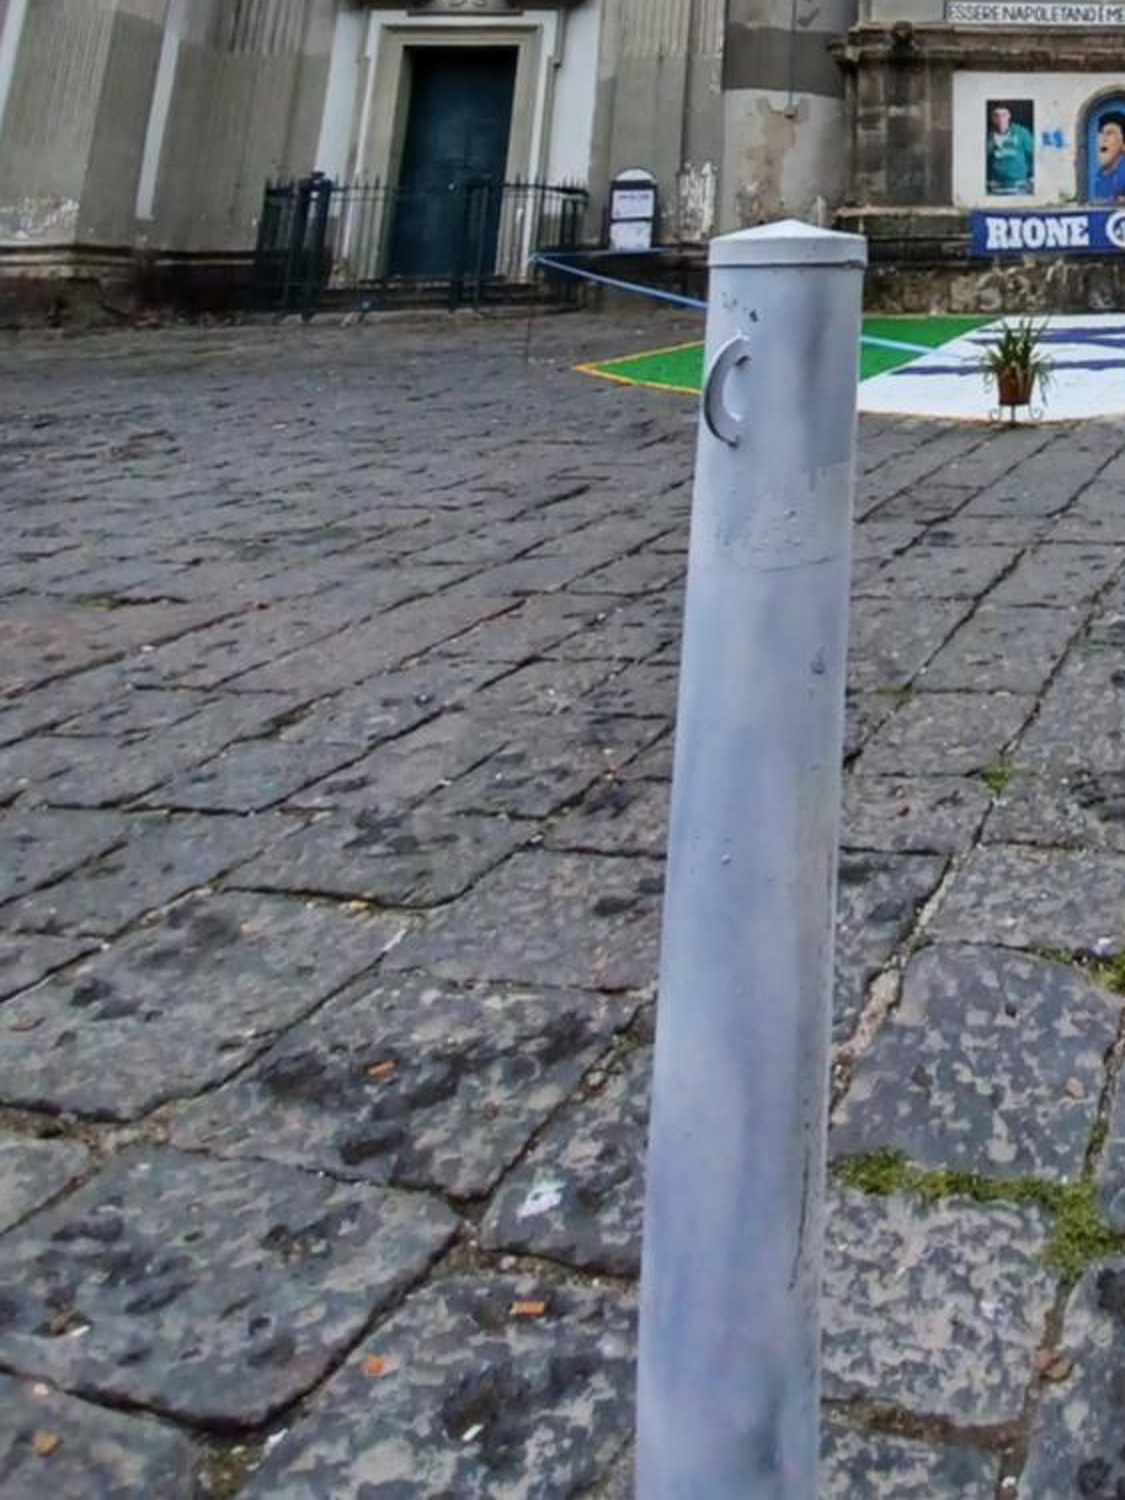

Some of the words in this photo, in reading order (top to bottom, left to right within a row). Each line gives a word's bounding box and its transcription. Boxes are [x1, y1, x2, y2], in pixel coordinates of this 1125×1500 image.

[949, 3, 1000, 21] ESSERE
[1001, 3, 1097, 22] NAPOLETANO
[986, 215, 1090, 250] RIONE
